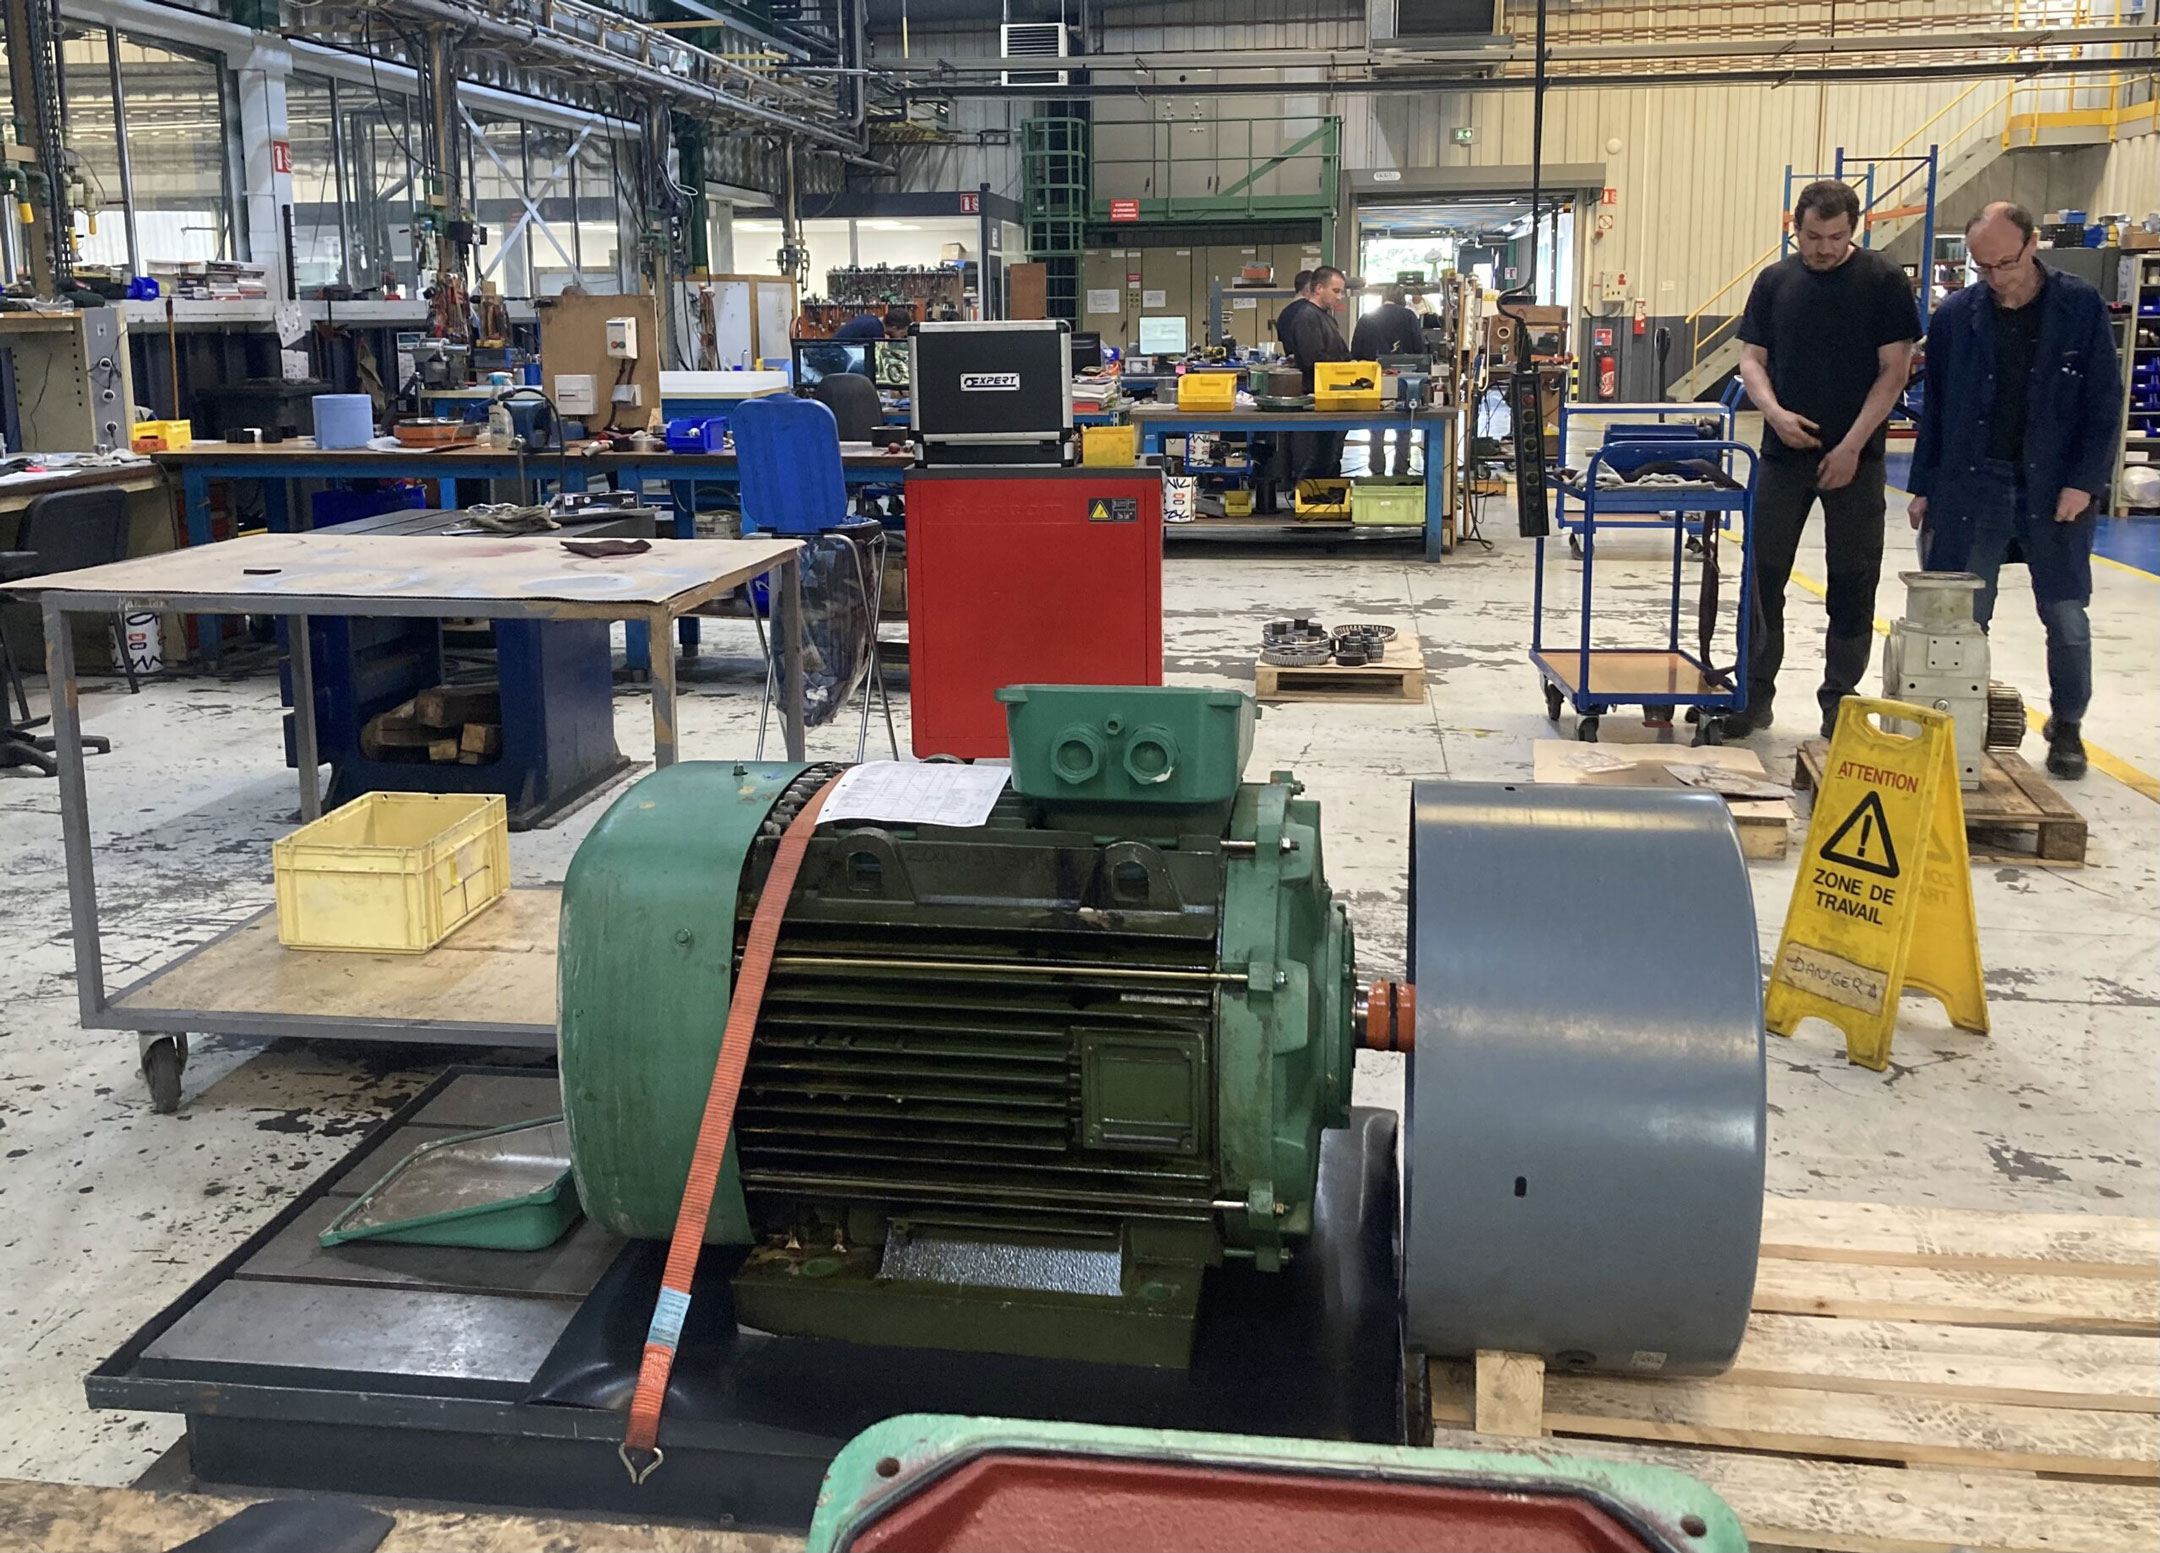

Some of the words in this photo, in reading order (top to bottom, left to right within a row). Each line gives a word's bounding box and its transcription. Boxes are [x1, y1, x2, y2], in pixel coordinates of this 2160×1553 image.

[1838, 761, 1919, 793] ATTENTION
[1813, 868, 1863, 896] ZONE
[1869, 884, 1896, 906] DE
[1816, 890, 1883, 925] TRAVAIL
[1791, 956, 1862, 994] DANGER
